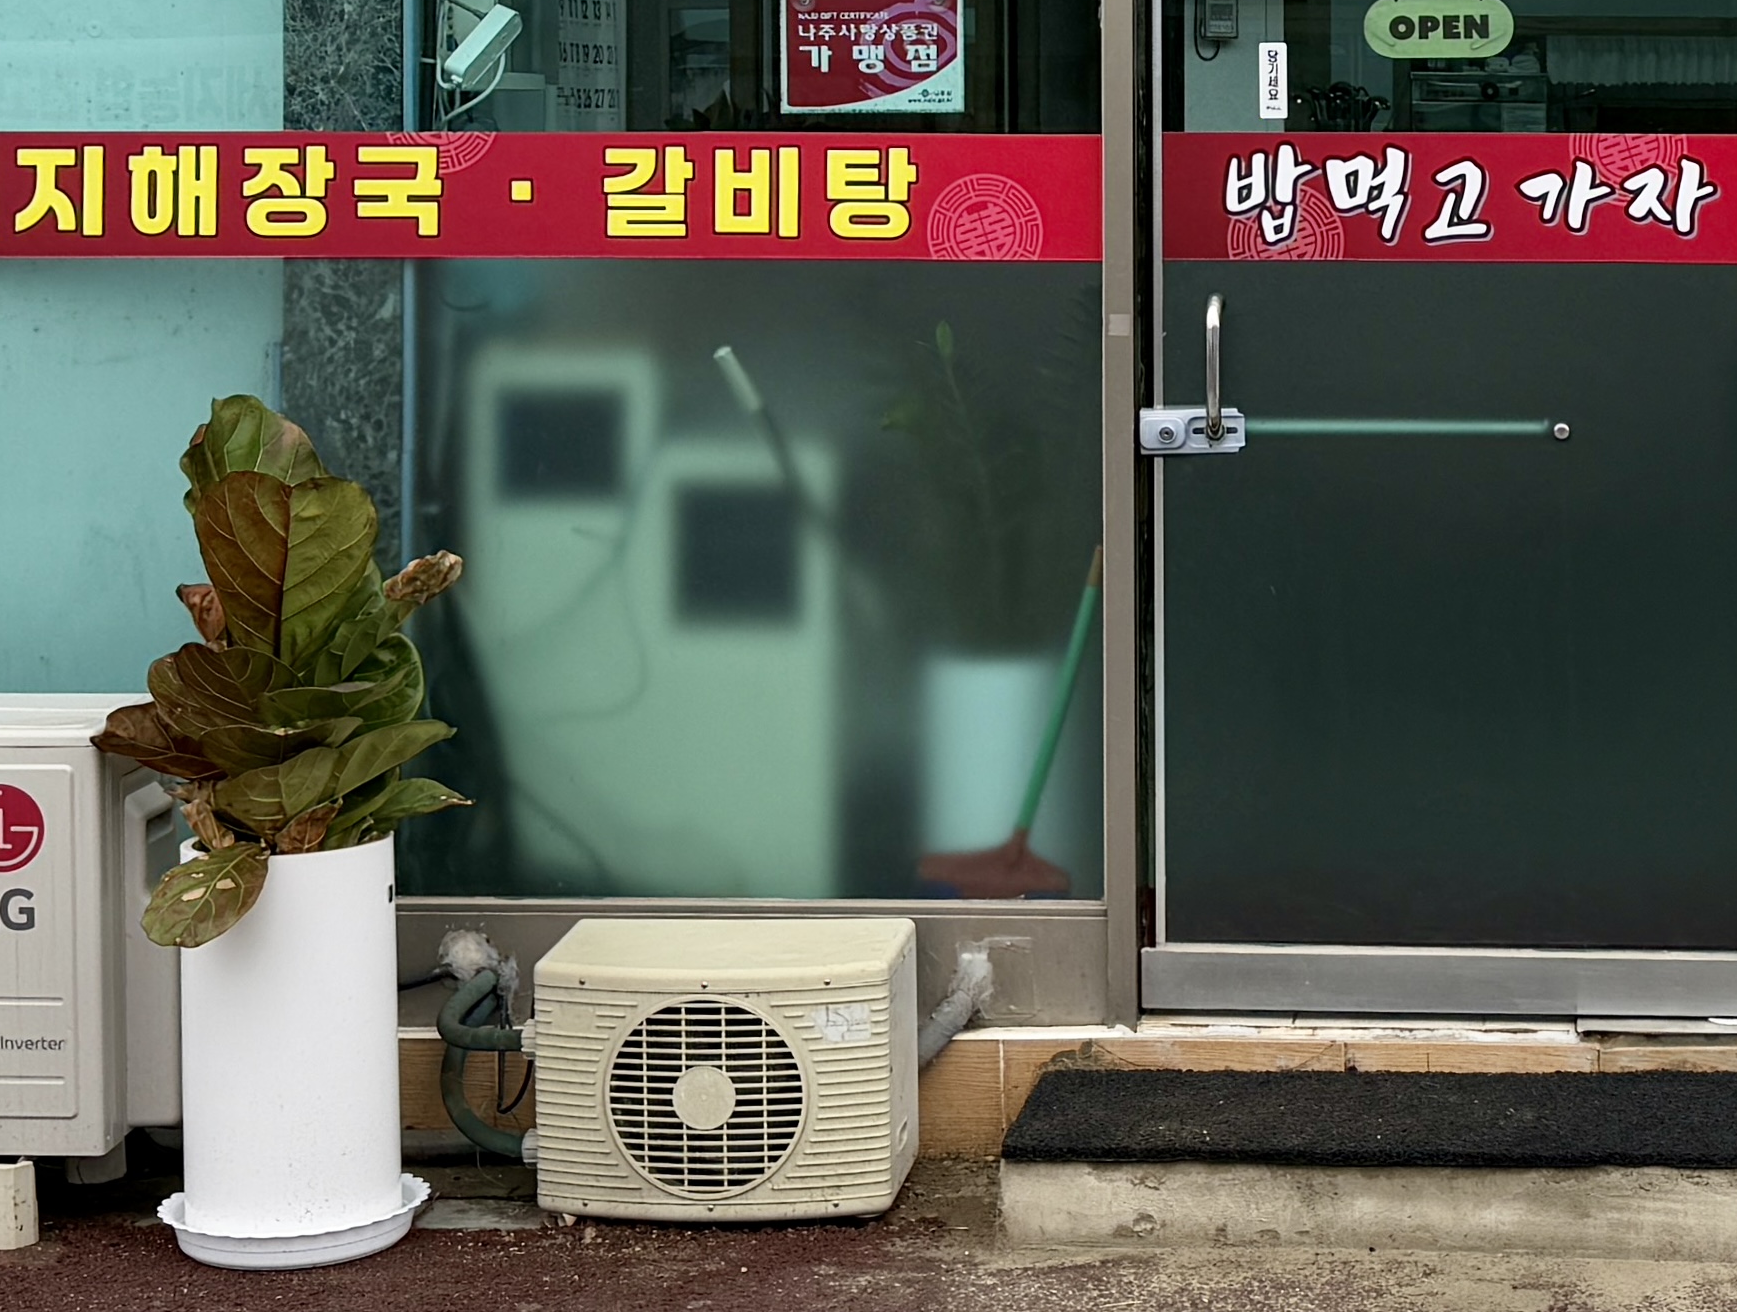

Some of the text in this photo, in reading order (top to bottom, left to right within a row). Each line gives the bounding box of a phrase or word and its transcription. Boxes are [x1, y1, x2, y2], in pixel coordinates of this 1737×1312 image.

[798, 23, 938, 41] 나주사랑상품권
[1388, 13, 1491, 41] OPEN
[592, 43, 604, 65] 20
[798, 45, 938, 74] 가맹점
[1267, 49, 1280, 101] 당기세요
[595, 88, 605, 109] 27
[605, 147, 918, 239] 갈비탕
[1517, 157, 1717, 235] 가자
[0, 1035, 65, 1051] Inverter
